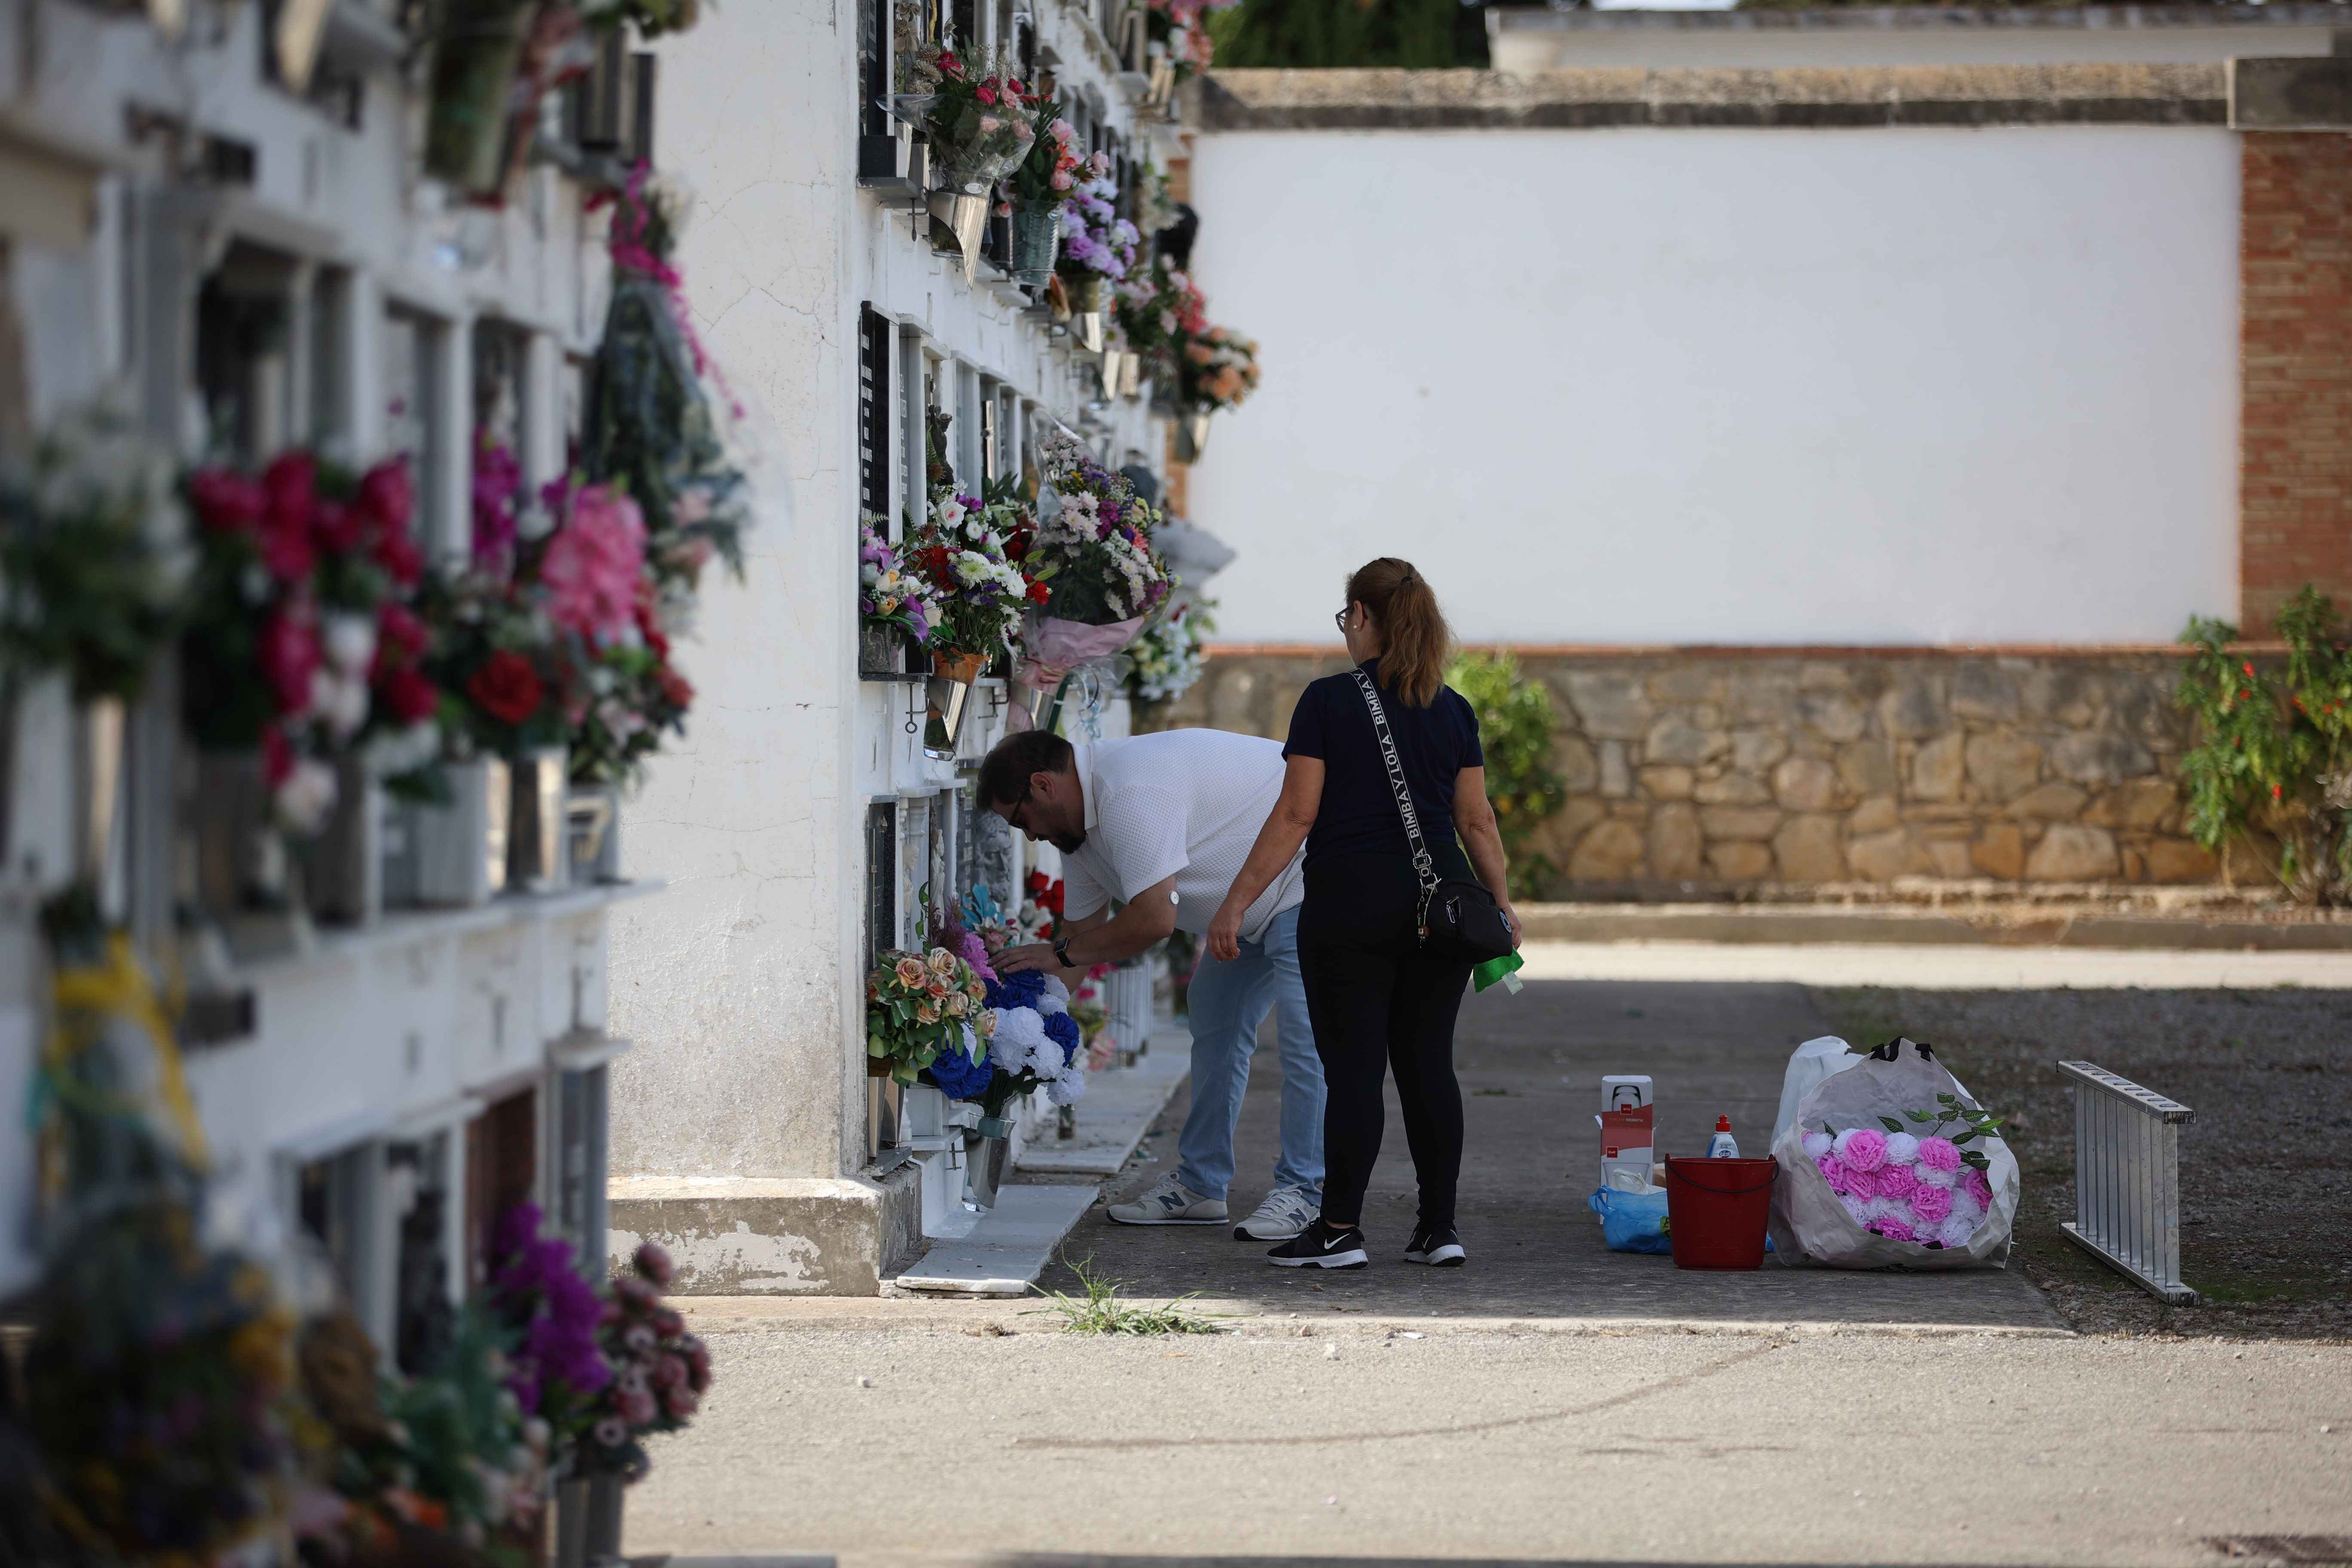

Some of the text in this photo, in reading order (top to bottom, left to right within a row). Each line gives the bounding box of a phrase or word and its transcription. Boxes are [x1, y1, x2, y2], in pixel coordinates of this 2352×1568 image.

[1362, 680, 1385, 726] BIMBA
[1381, 734, 1400, 773] LOLA
[1398, 790, 1419, 839] BIMBA
[1158, 1191, 1186, 1211] N
[1288, 1207, 1308, 1228] N
